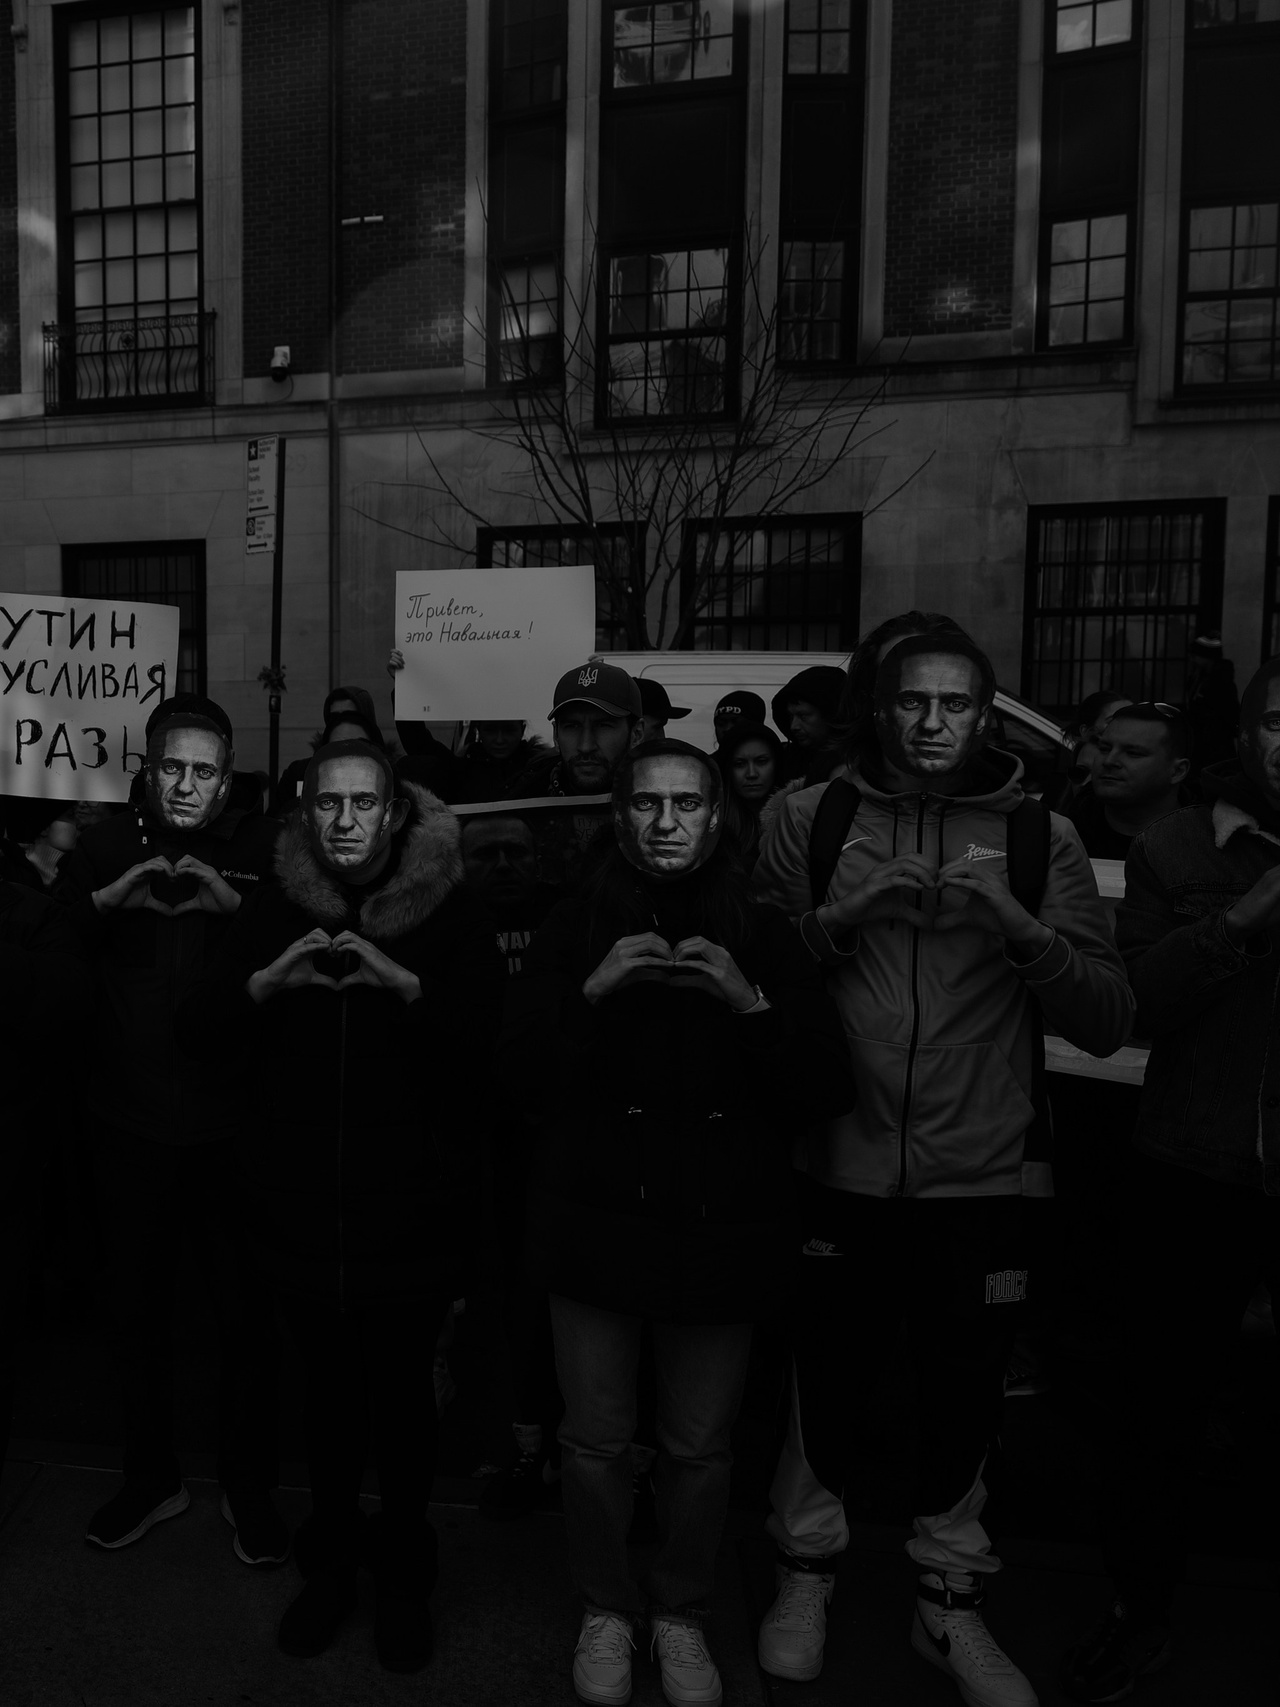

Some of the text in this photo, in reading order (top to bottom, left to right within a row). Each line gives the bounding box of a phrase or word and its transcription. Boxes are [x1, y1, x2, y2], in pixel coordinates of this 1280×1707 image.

[406, 592, 484, 628] Привет,
[404, 629, 433, 643] это
[227, 870, 260, 881] Columbia
[807, 1237, 836, 1254] NIKE
[984, 1269, 1029, 1304] FORCE
